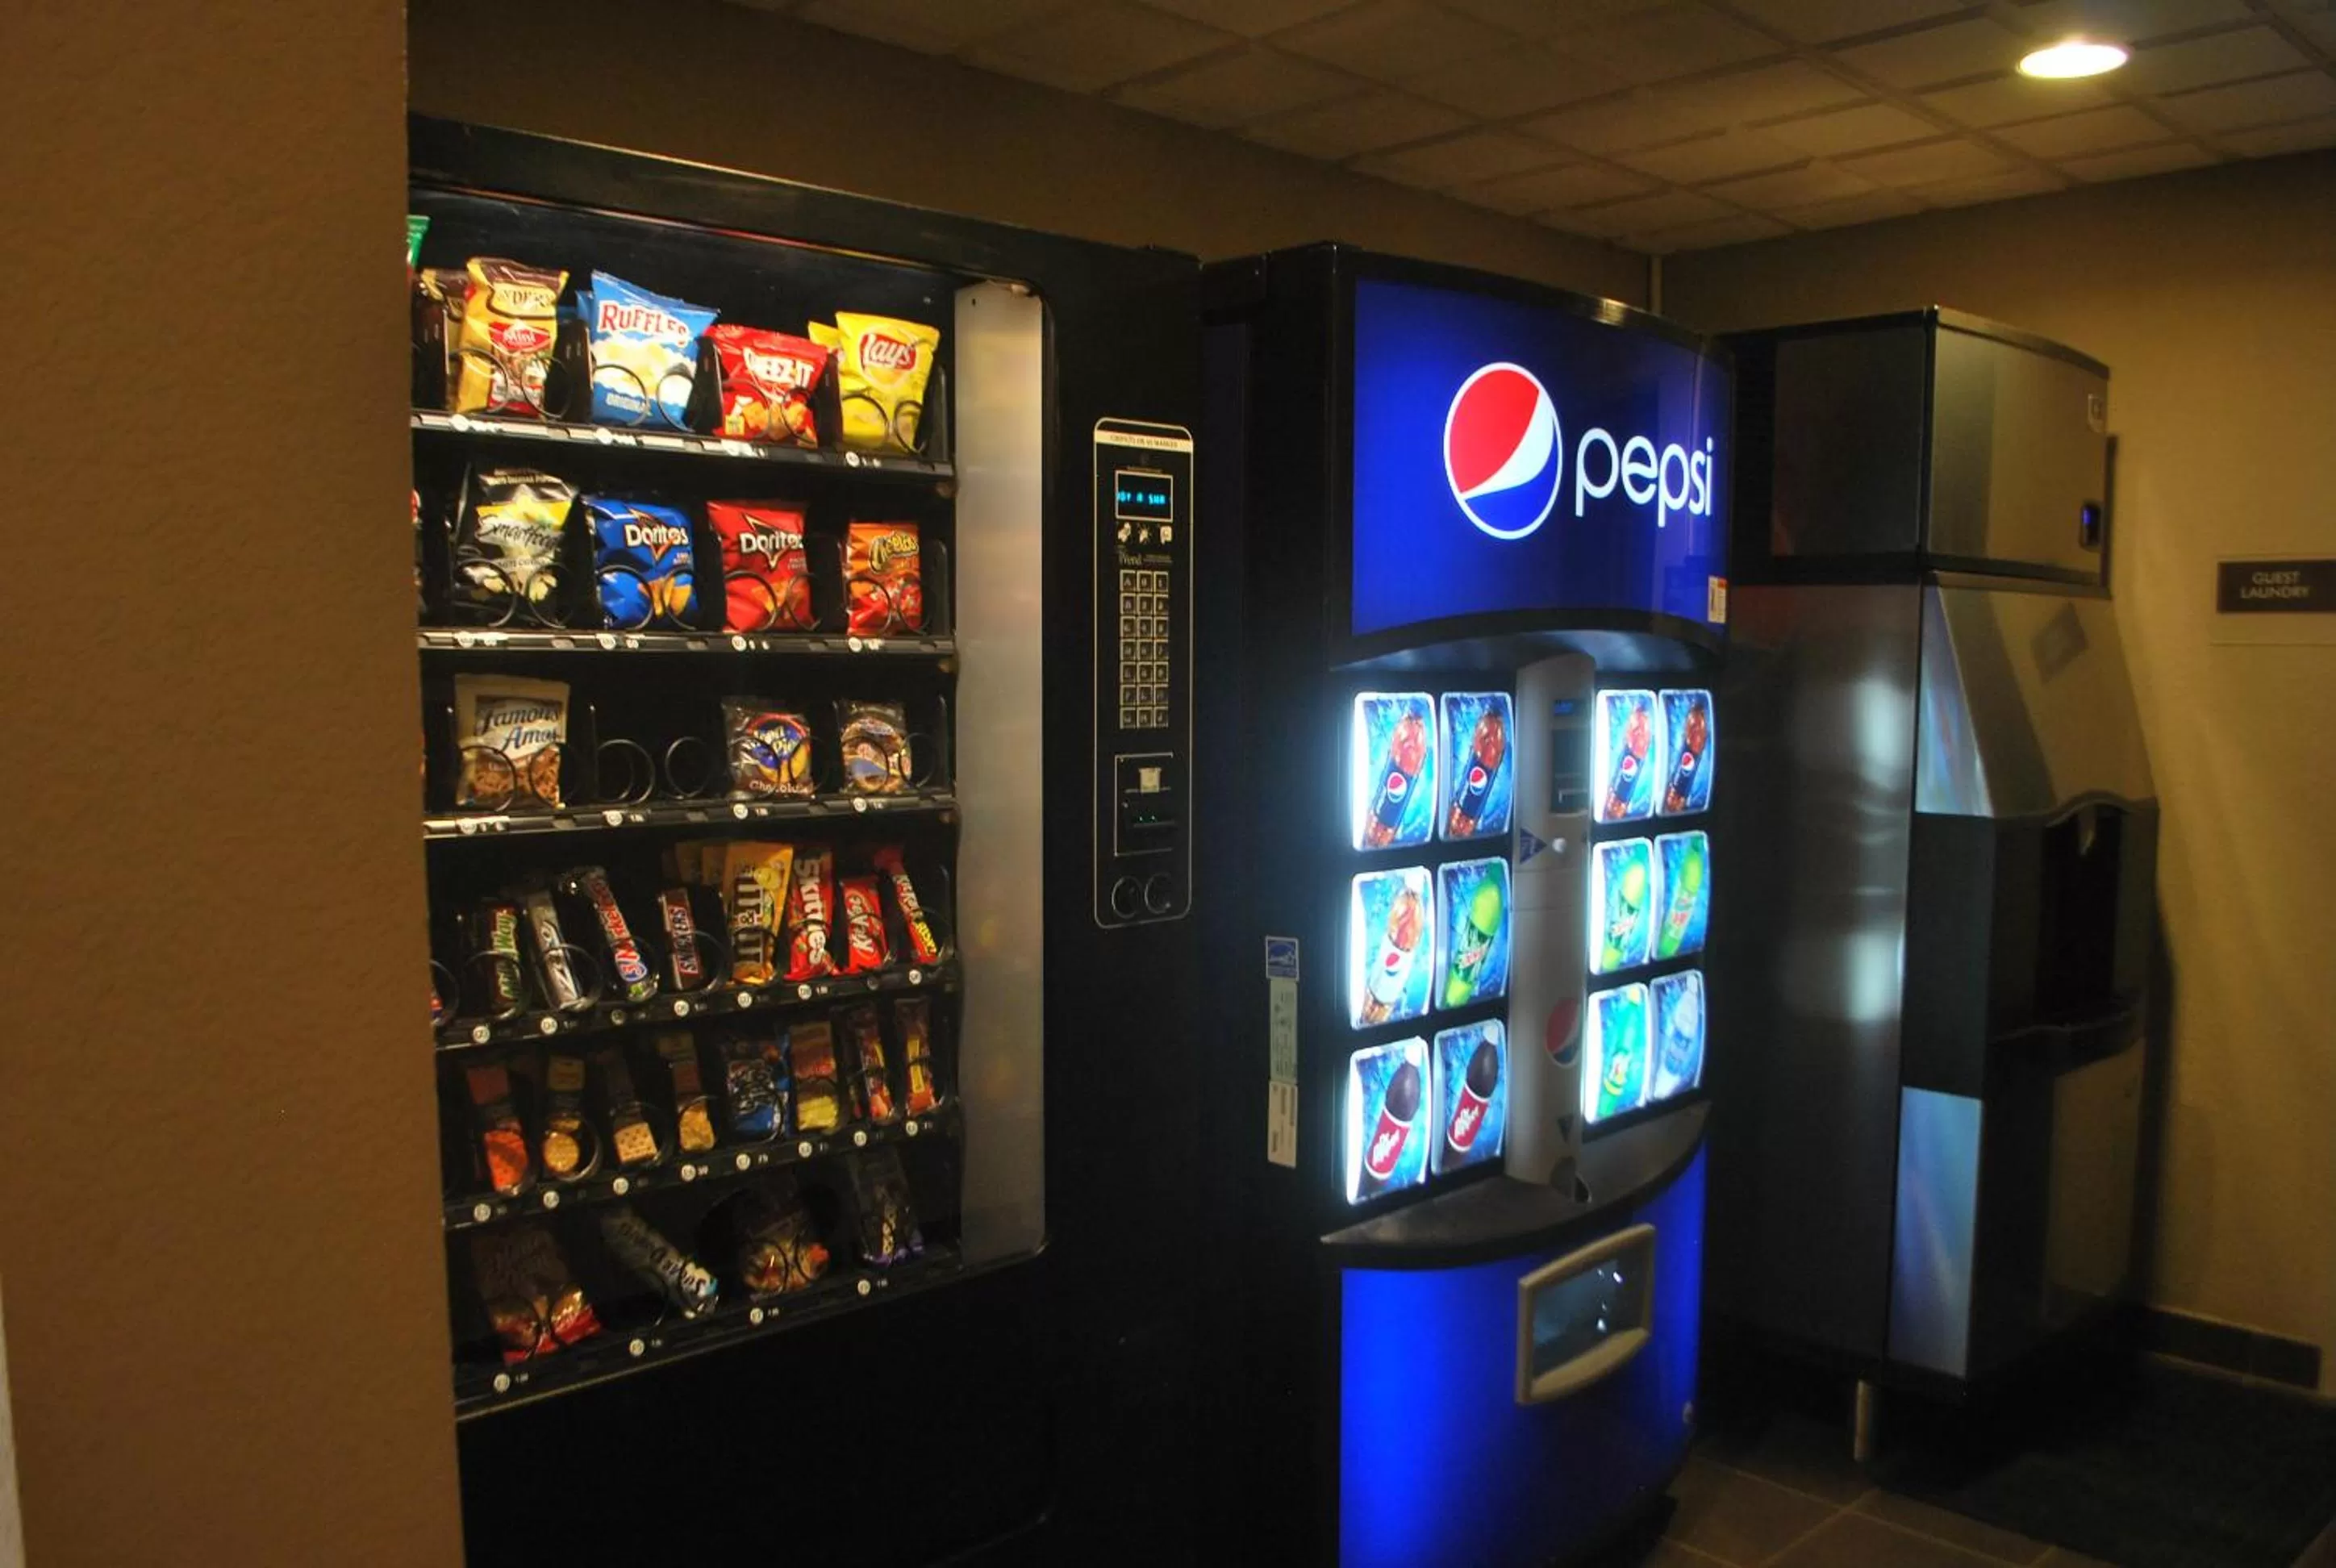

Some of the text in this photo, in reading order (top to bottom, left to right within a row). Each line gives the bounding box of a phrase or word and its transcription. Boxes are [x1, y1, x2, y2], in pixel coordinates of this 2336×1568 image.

[599, 302, 687, 347] RUFFLES
[1575, 427, 1713, 528] pepsi
[624, 524, 689, 547] Doritos
[2240, 585, 2310, 598] LAUNDRY
[2252, 571, 2301, 585] GUEST
[473, 708, 559, 736] Famous
[500, 725, 558, 753] Amos
[794, 857, 828, 965] Skittles
